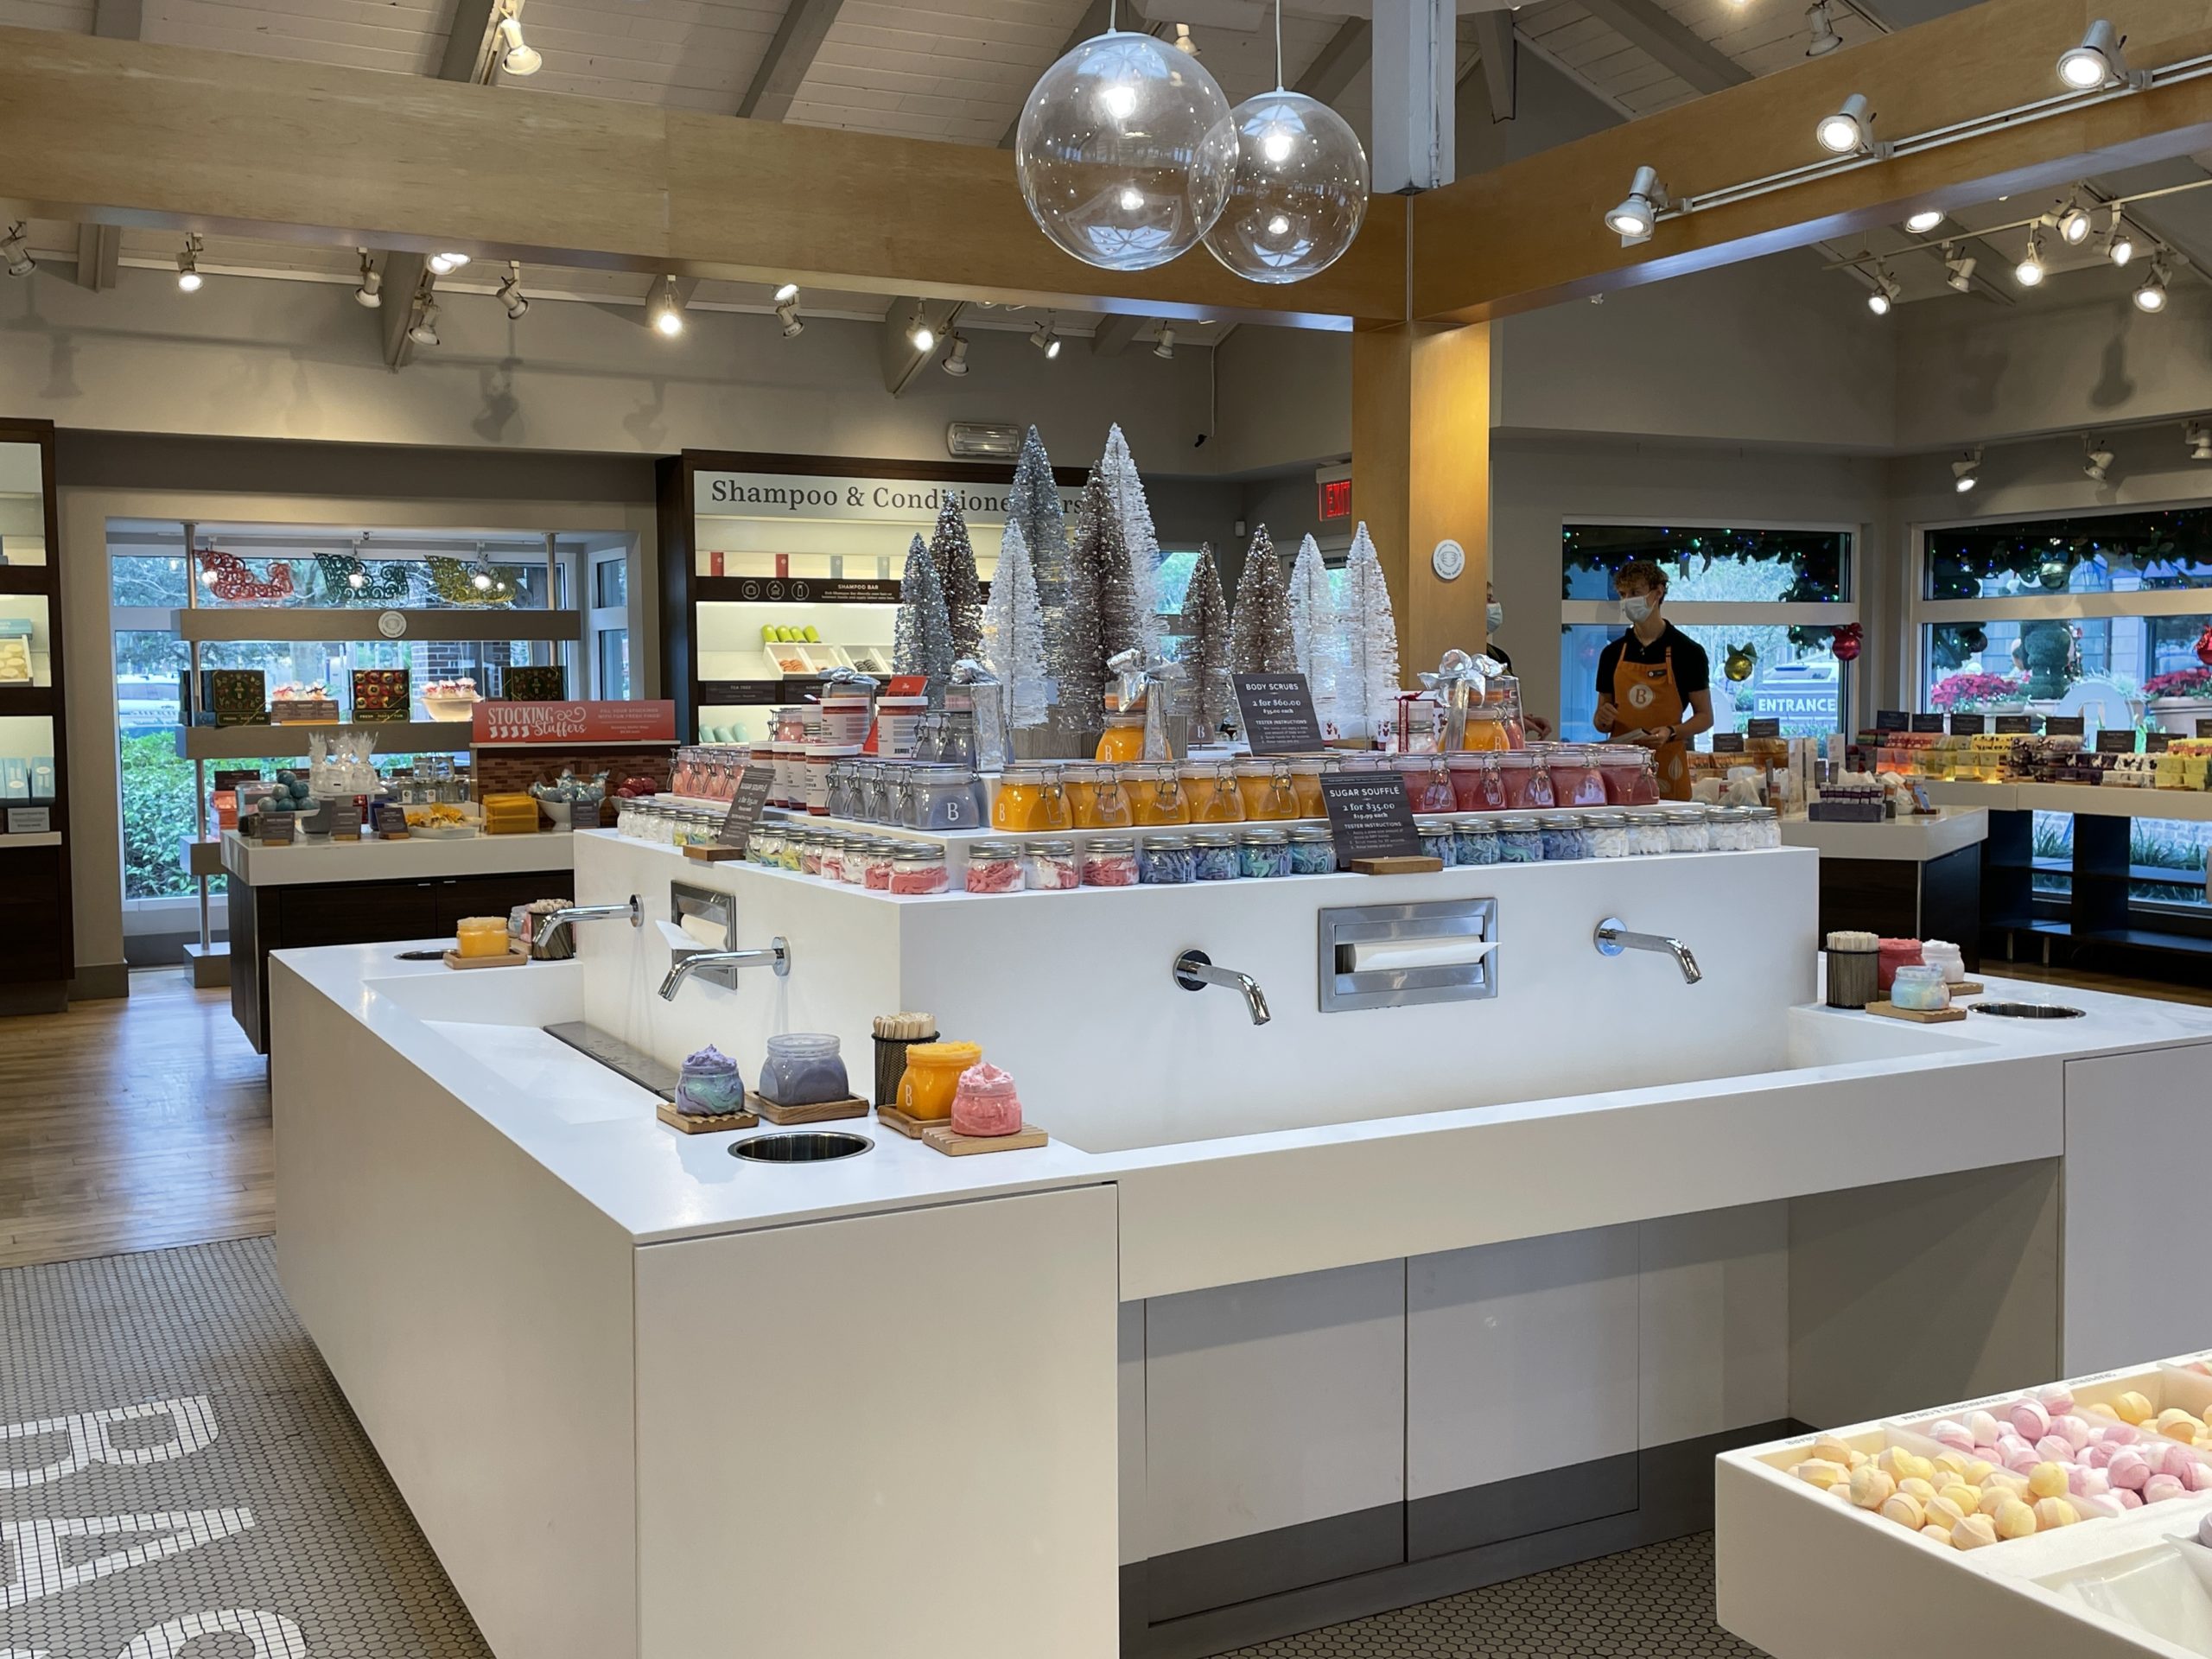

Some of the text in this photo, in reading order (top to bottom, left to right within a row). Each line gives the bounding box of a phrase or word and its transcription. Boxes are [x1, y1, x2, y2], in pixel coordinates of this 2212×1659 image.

[711, 479, 838, 512] Shampoo
[847, 486, 865, 506] &
[1245, 683, 1267, 691] BODY
[1635, 688, 1647, 704] B
[1758, 697, 1837, 714] ENTRANCE
[487, 705, 554, 726] STOCKING
[531, 719, 588, 738] Stuffers
[1104, 745, 1112, 762] B
[1329, 785, 1401, 798] SUGAR SOUFFLÉ
[947, 802, 959, 821] B
[999, 803, 1006, 822] B
[1350, 803, 1363, 811] for
[1366, 802, 1395, 812] $35.00
[905, 1084, 913, 1107] B
